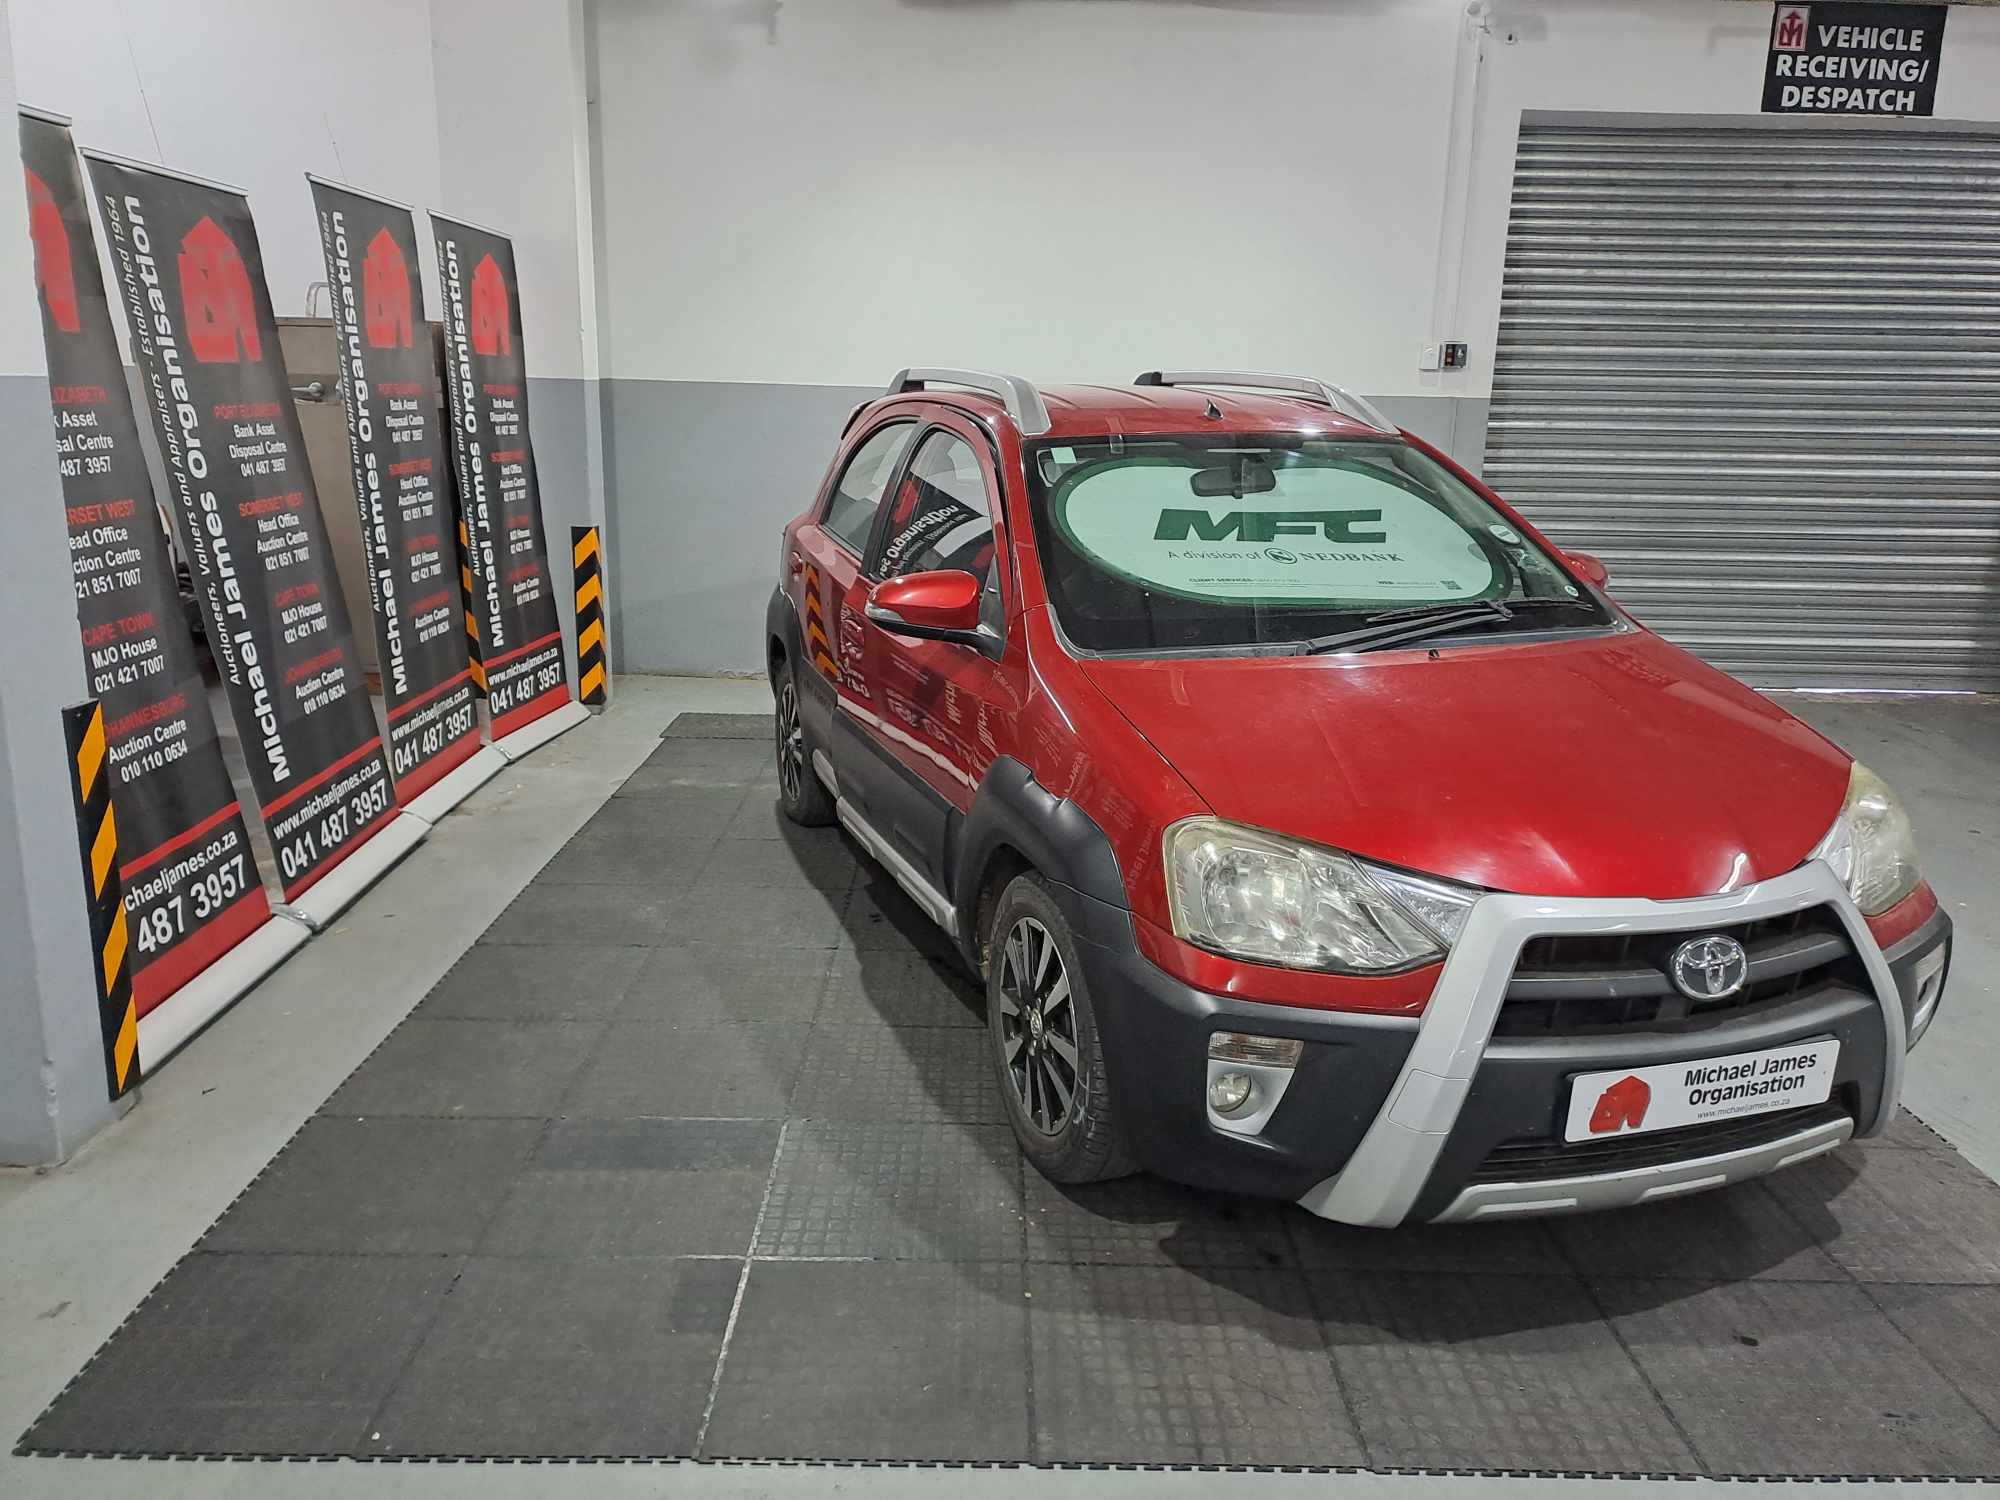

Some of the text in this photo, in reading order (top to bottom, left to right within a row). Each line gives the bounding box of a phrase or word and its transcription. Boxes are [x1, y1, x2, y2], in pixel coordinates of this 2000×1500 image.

[1818, 25, 1924, 51] VEHICLE
[1775, 54, 1930, 83] RECEIVING/
[1781, 85, 1915, 112] DESPATCH
[104, 194, 125, 243] 1964
[117, 247, 155, 357] Established
[62, 410, 98, 427] Asset
[151, 371, 183, 468] Appraisers
[76, 433, 113, 450] Centre
[228, 441, 265, 460] Disposal
[332, 210, 408, 696] Michael James Organisation
[349, 435, 360, 464] and
[446, 239, 505, 648] Michael James Organisation
[455, 426, 465, 451] and
[60, 455, 111, 477] 487 3957
[124, 194, 291, 784] Michael James Organisation
[174, 470, 193, 507] and
[65, 503, 102, 525] RSET
[1153, 508, 1387, 544] MFC
[69, 525, 128, 550] ead Office
[257, 536, 286, 554] Auction
[73, 547, 141, 574] ction Centre
[265, 554, 280, 571] 021
[1168, 550, 1406, 563] A division of NEDBANK
[91, 574, 114, 595] 851
[115, 567, 141, 588] 7007
[297, 602, 322, 618] House
[82, 612, 156, 646] CAPE TOWN
[207, 582, 243, 686] Auctioneers,
[91, 637, 158, 669] MJO House
[94, 654, 165, 693] 021 421 7007
[295, 678, 321, 700] Auction
[321, 667, 345, 686] Centre
[490, 662, 562, 714] 041 487 3957
[108, 719, 187, 764] Auction Centre
[394, 703, 473, 775] 041 487 3957
[120, 738, 188, 783] 010 110 0634
[273, 757, 382, 841] www.michaeljames.co.za
[280, 777, 390, 879] 041 487 3957
[124, 830, 238, 914] chaeljames.co.za
[136, 853, 247, 955] 487 3957
[1683, 1053, 1818, 1088] Michael James
[1688, 1072, 1806, 1106] Organisation
[1696, 1097, 1792, 1119] www.michaeljames.co.za
